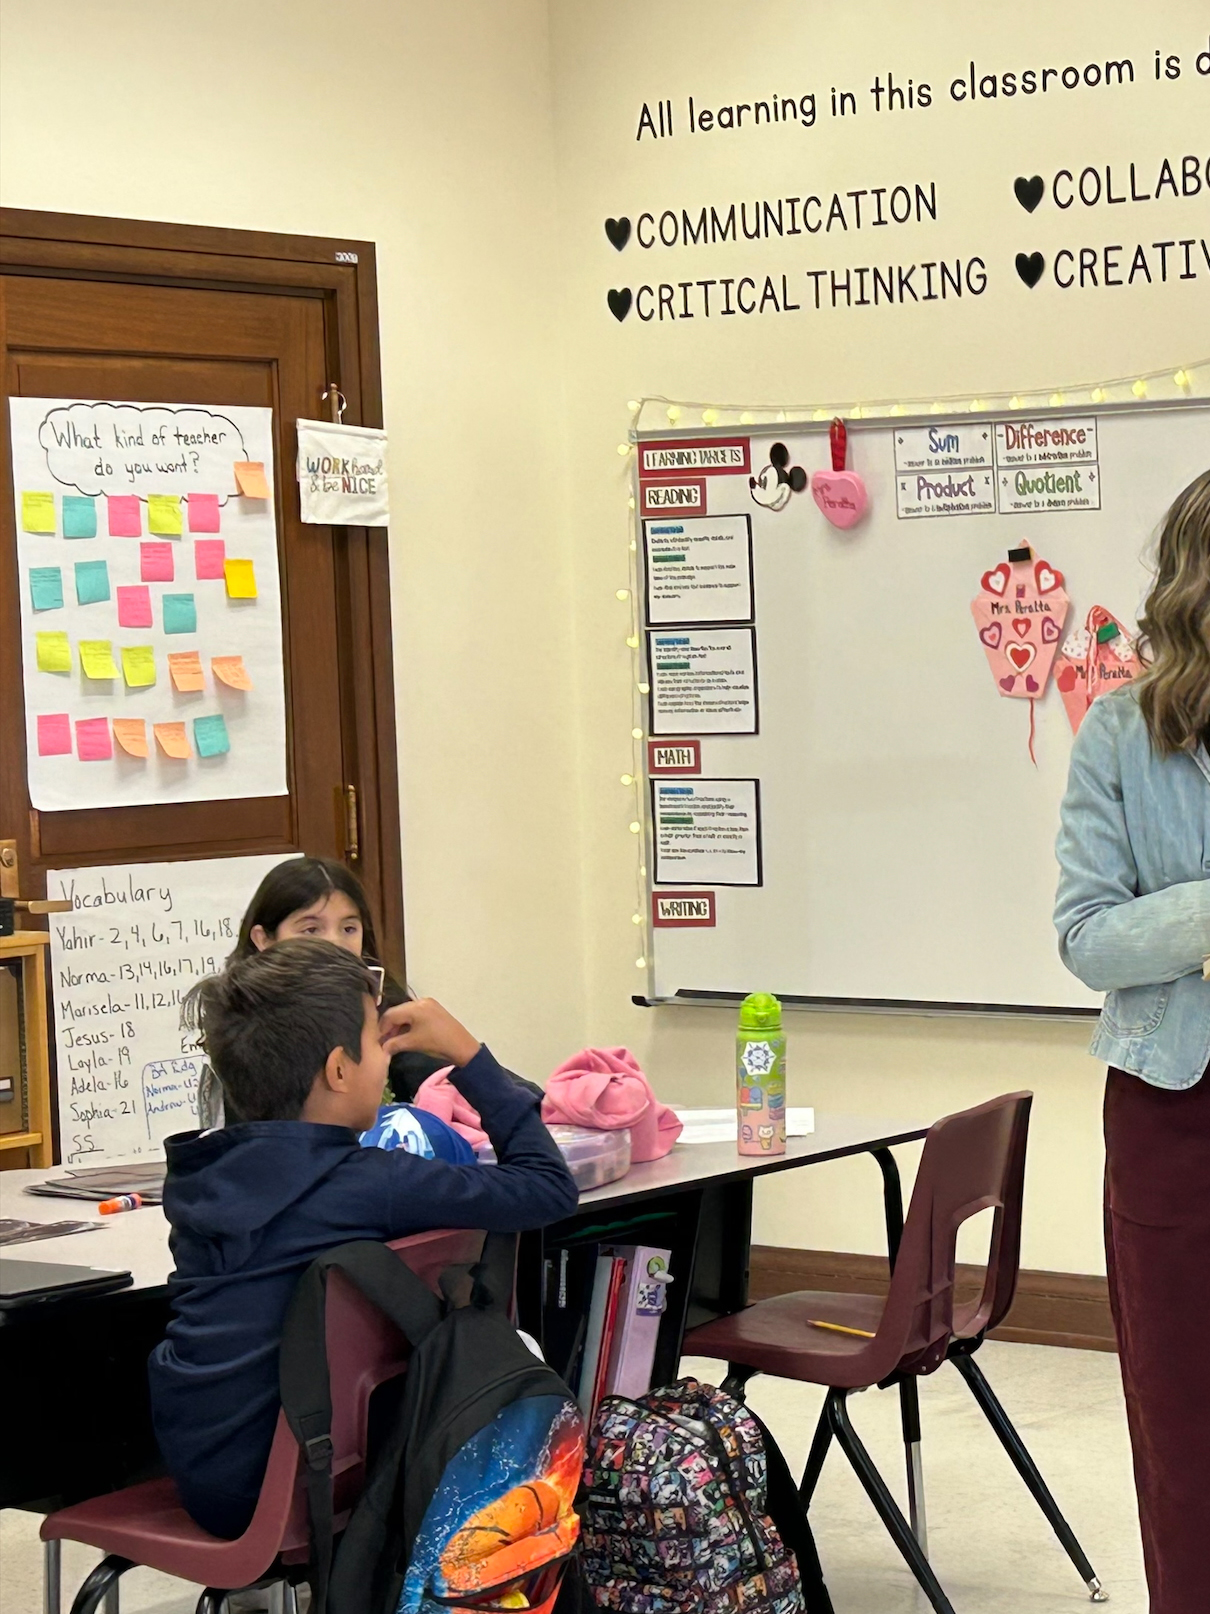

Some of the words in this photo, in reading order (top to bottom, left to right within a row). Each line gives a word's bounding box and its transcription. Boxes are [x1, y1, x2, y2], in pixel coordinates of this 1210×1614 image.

[636, 99, 674, 141] All
[689, 94, 816, 133] learning
[830, 87, 857, 116] in
[870, 72, 932, 111] this
[950, 61, 1134, 102] classroom
[1154, 50, 1181, 80] is
[636, 182, 937, 249] COMMUNICATION
[635, 274, 800, 322] CRITICAL
[806, 257, 988, 309] THINKING
[50, 421, 102, 448] What
[113, 424, 144, 448] kind
[152, 425, 168, 445] of
[173, 426, 227, 446] teacher
[928, 427, 960, 453] Sum
[1004, 423, 1087, 450] Difference
[94, 457, 113, 476] do
[125, 463, 151, 483] you
[306, 456, 350, 475] WORK
[322, 475, 340, 493] be
[341, 476, 376, 495] NICE
[916, 474, 976, 501] Product
[1014, 469, 1083, 496] Quotient
[648, 487, 698, 505] READING
[657, 748, 691, 765] MATH
[60, 873, 173, 912] Vocabulary
[660, 901, 708, 917] WRITING
[120, 1021, 136, 1039] 18
[118, 1046, 132, 1066] 19
[119, 1099, 136, 1115] 21
